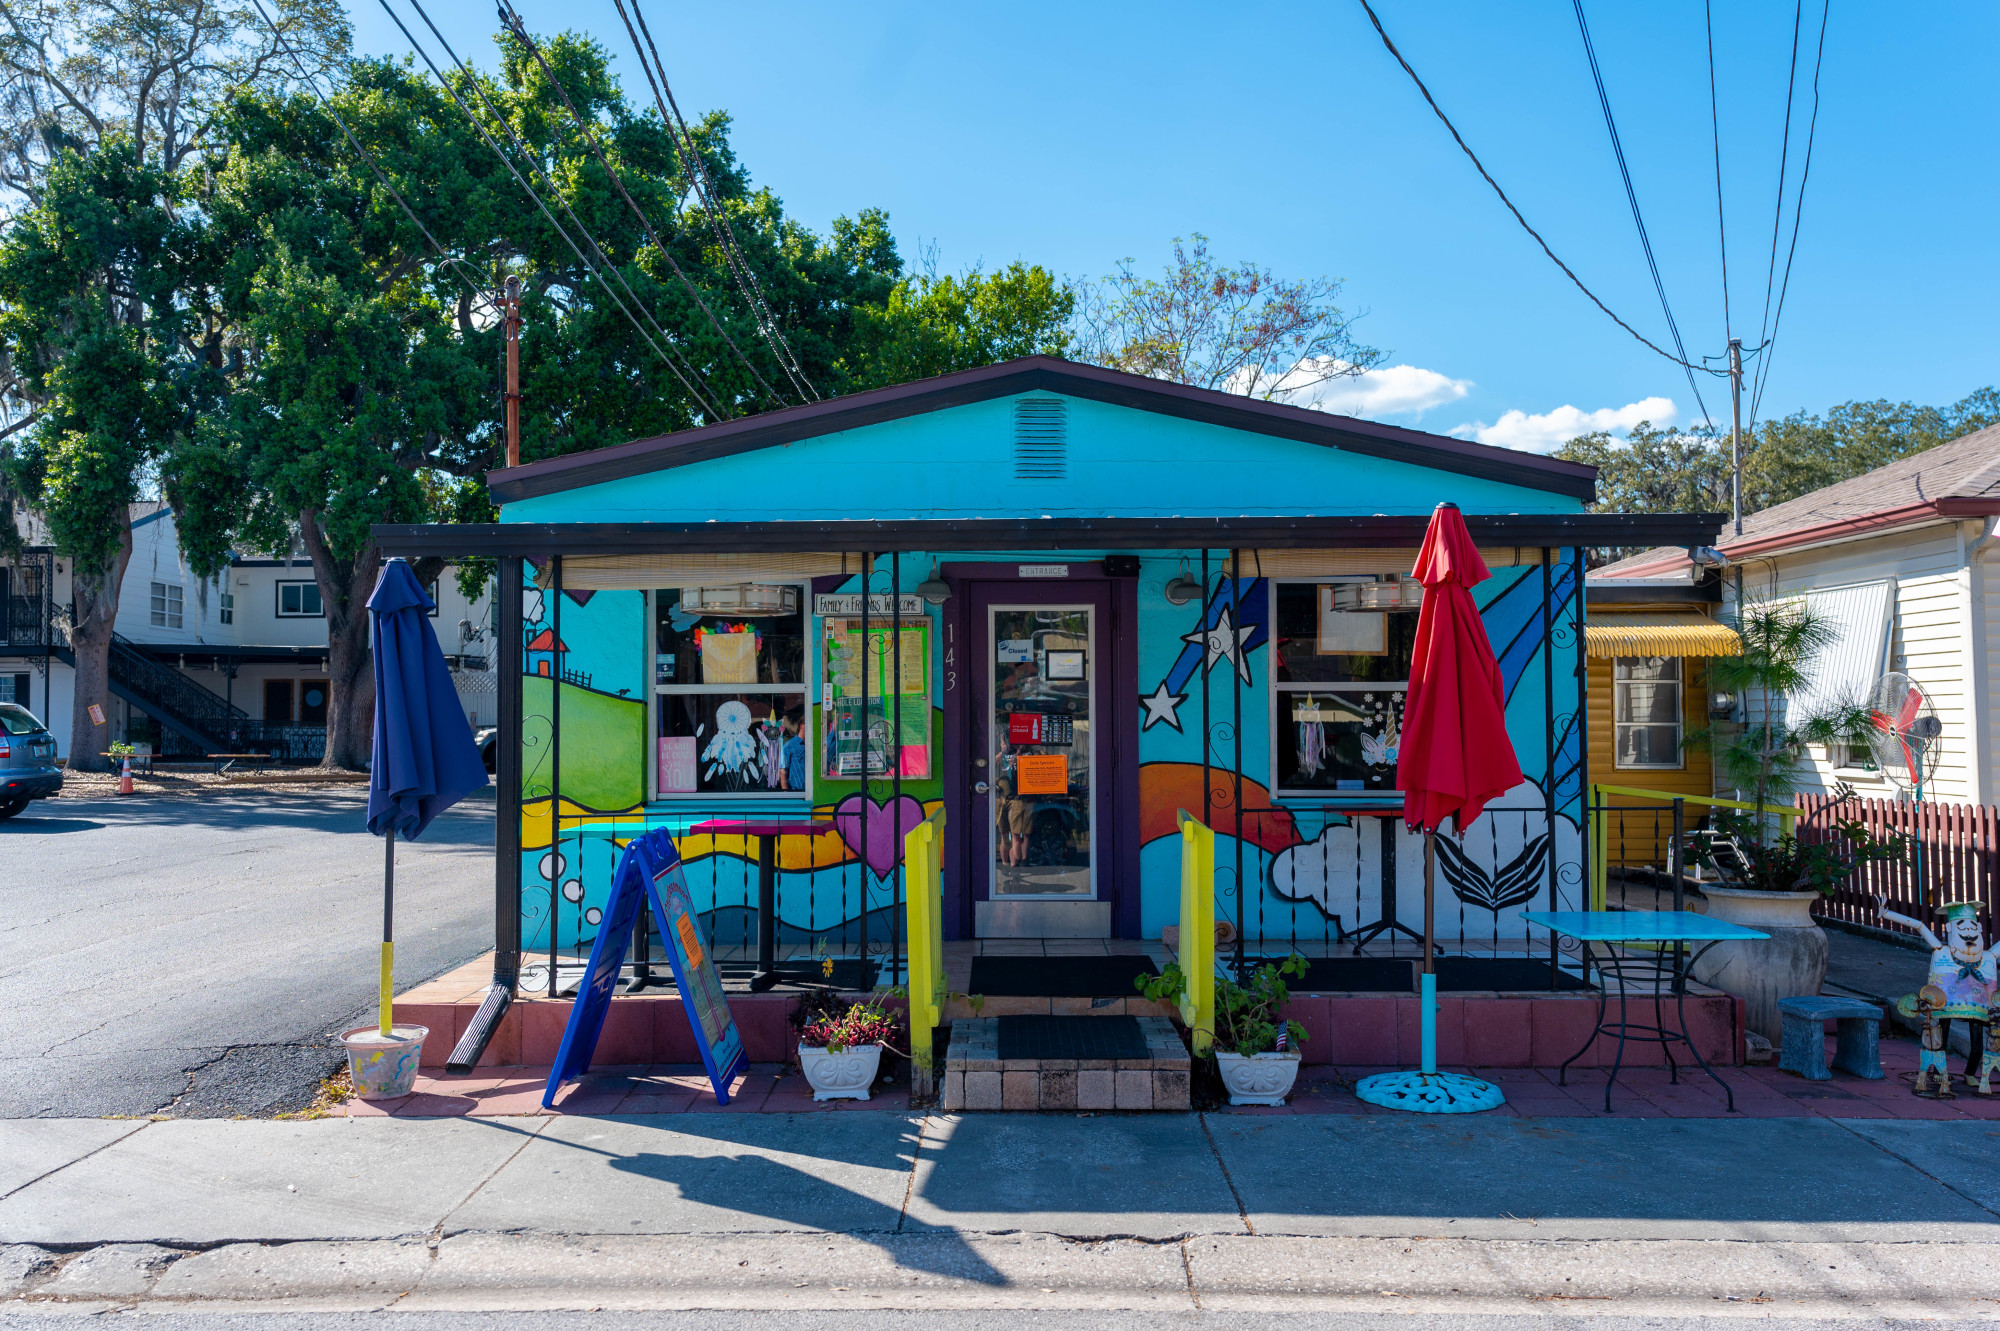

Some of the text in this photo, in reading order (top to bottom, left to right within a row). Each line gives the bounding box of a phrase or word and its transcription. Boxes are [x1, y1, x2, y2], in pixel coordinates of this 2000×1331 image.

[1025, 567, 1062, 575] ENTRANCE
[820, 596, 844, 612] FAMILY
[851, 596, 880, 612] FRINDS
[884, 596, 917, 612] WECOME
[662, 763, 695, 789] YOU
